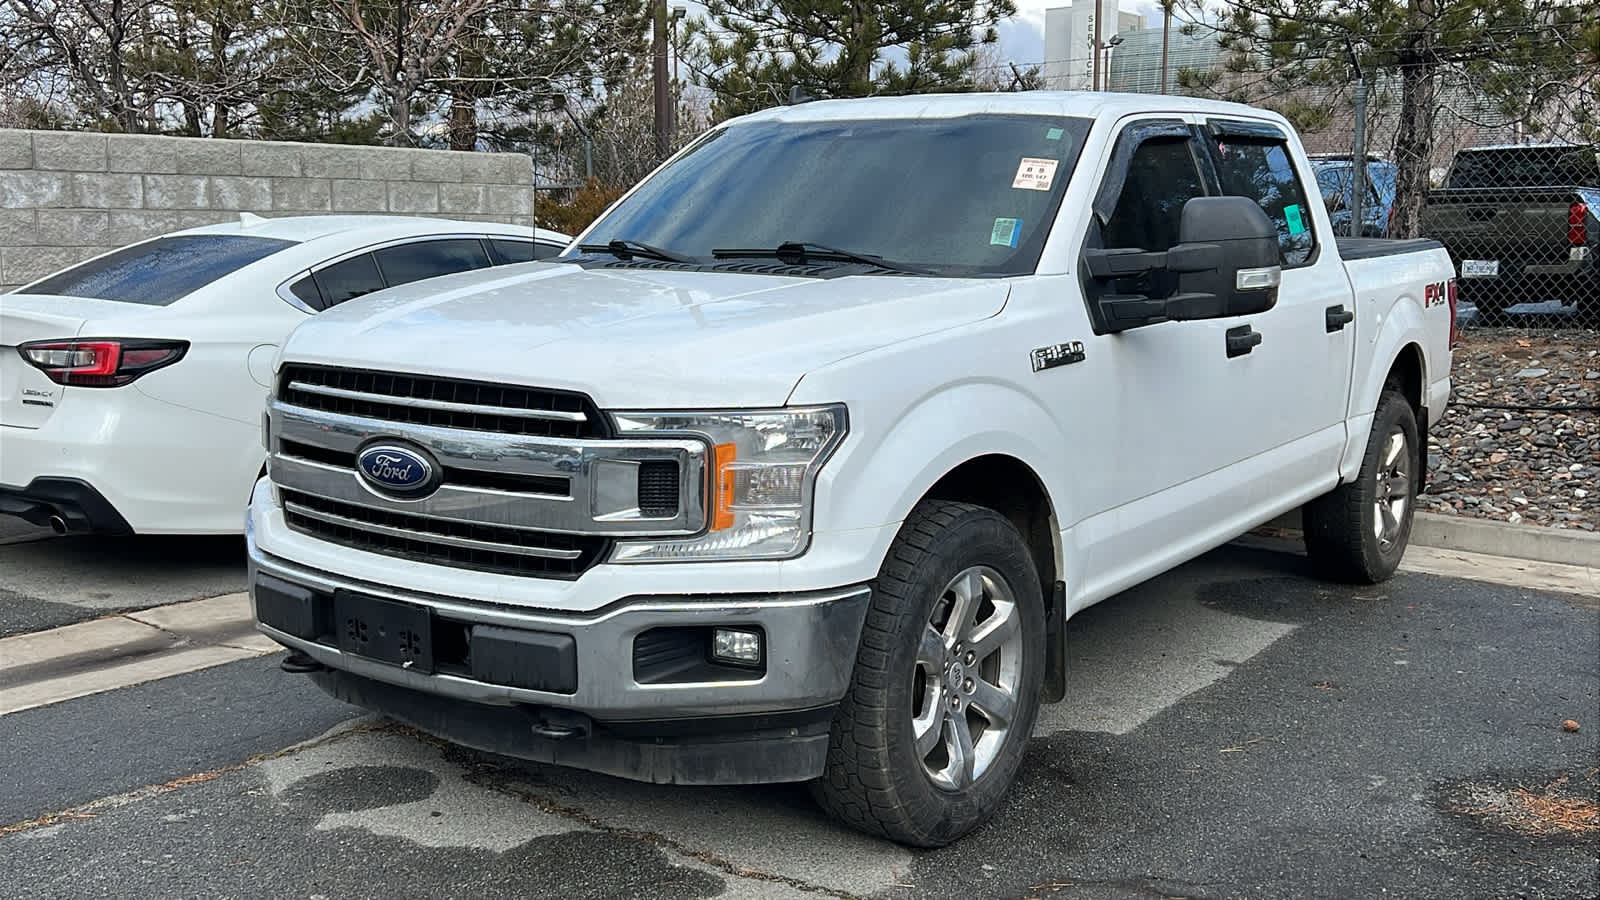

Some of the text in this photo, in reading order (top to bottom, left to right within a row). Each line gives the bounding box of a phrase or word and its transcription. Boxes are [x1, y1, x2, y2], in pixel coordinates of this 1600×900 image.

[1086, 15, 1094, 78] SERVICE
[1425, 281, 1445, 308] FX4
[372, 454, 412, 481] Ford
